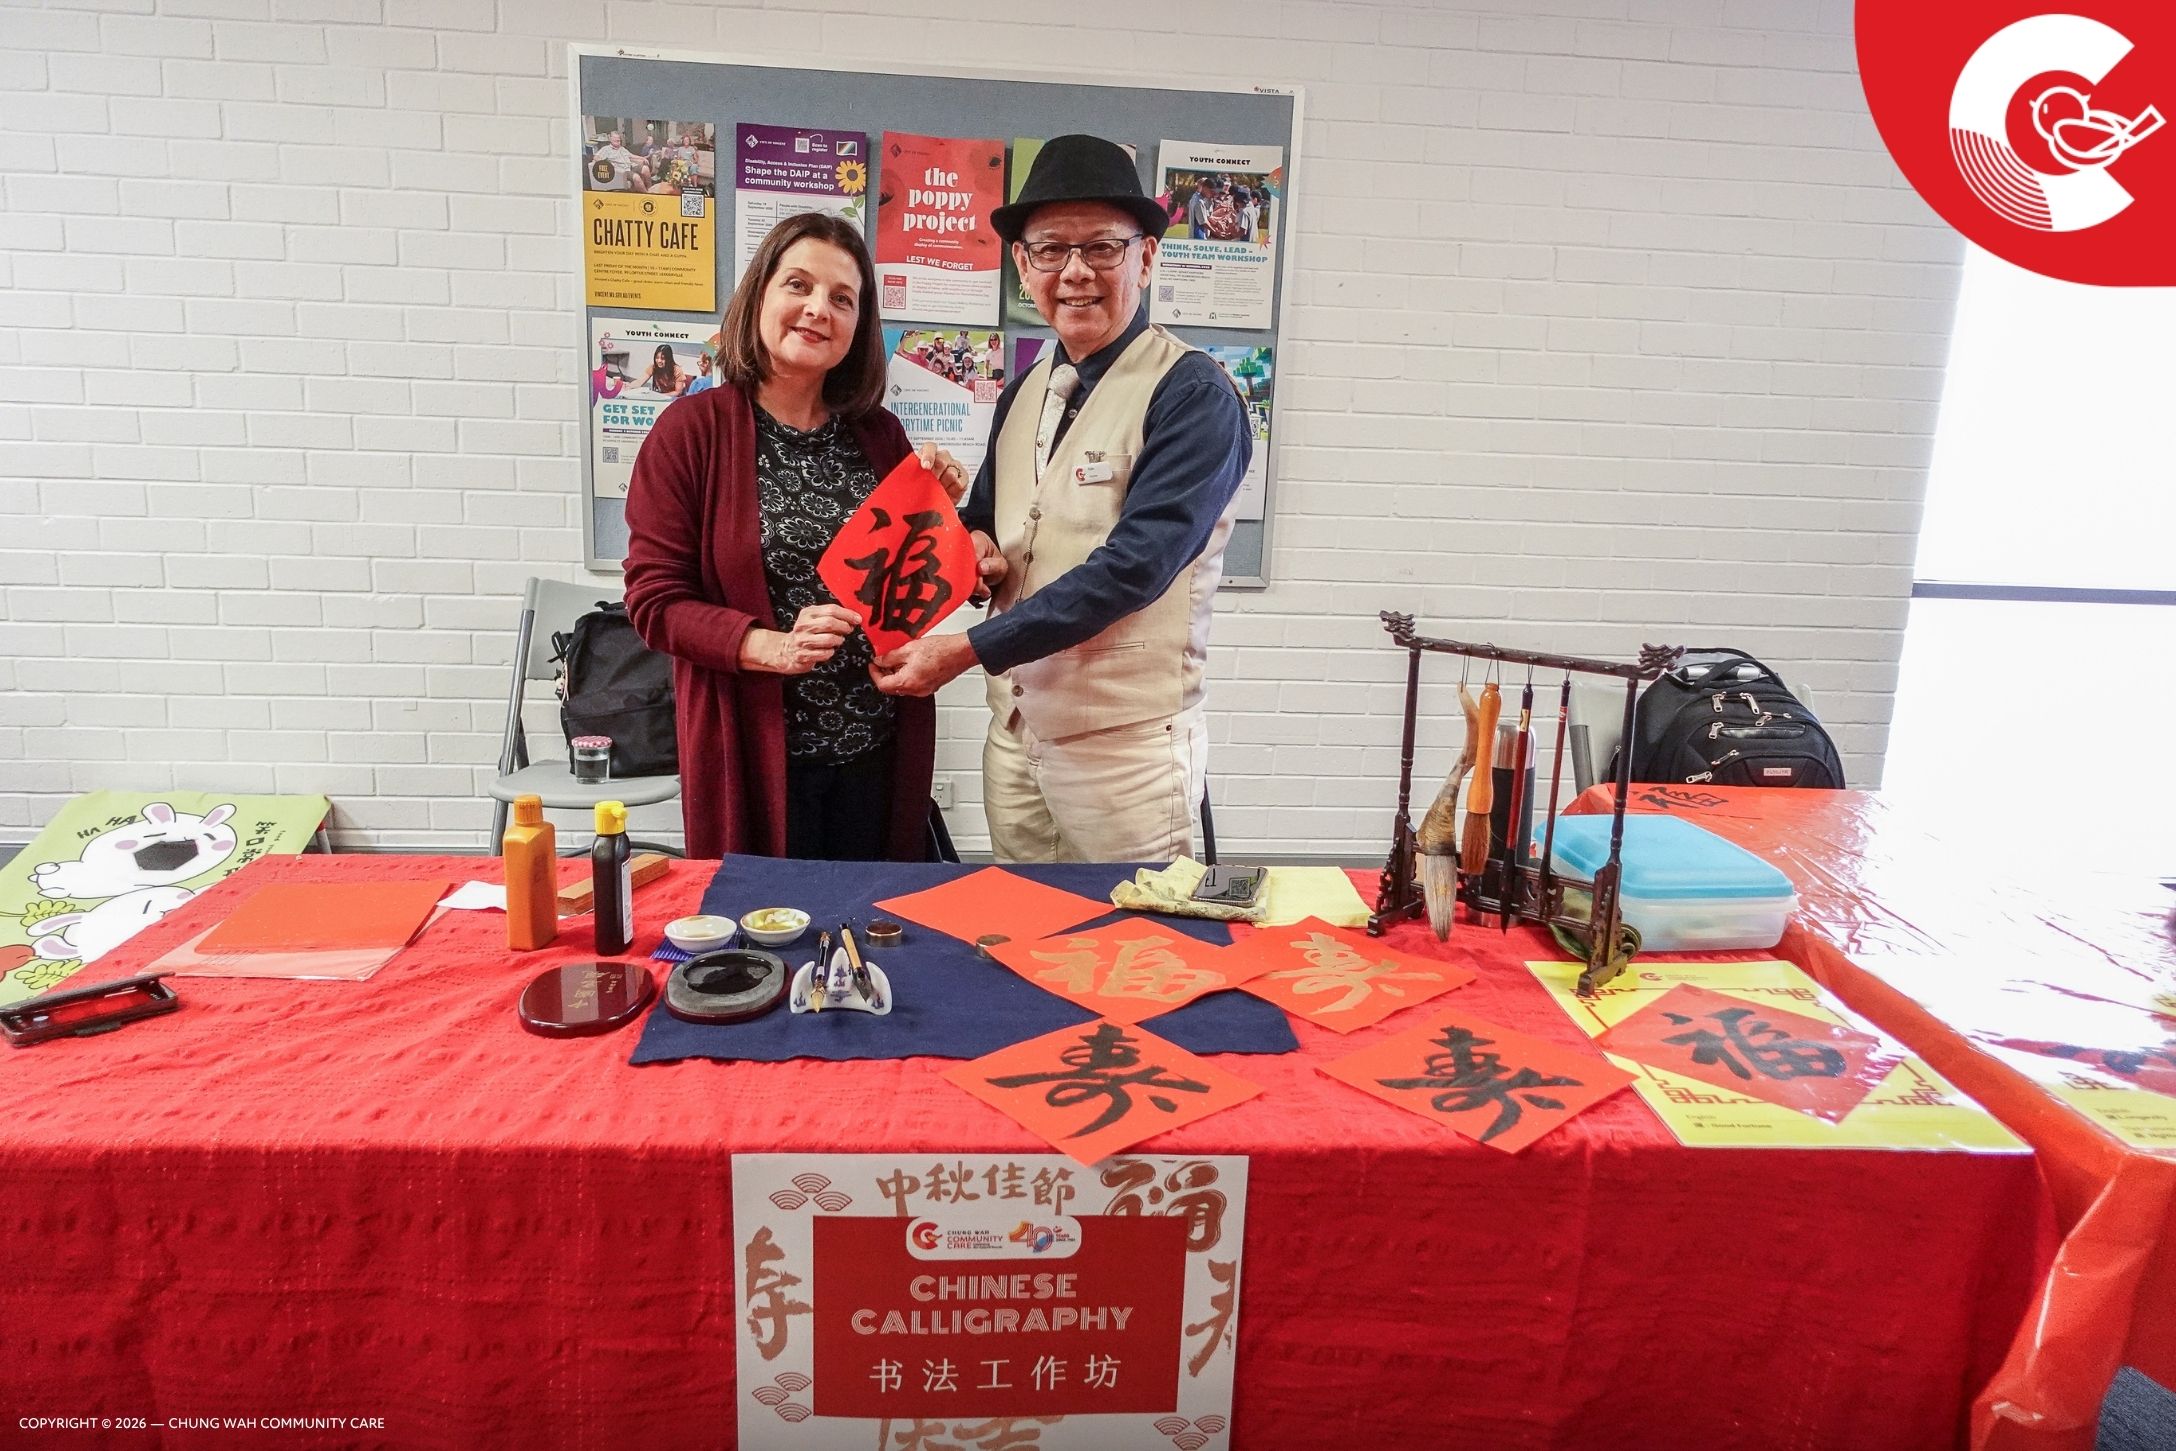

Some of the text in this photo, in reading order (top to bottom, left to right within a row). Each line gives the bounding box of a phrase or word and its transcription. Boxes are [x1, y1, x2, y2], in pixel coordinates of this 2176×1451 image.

[1189, 156, 1251, 166] YOUTH CONNECT
[745, 166, 772, 176] Shape
[774, 168, 788, 177] the
[790, 170, 810, 178] DAIP
[924, 168, 959, 188] the
[745, 178, 835, 192] community workshop
[908, 188, 972, 212] poppy
[902, 212, 976, 234] project
[594, 218, 698, 250] CHATTY CAFE
[1192, 252, 1215, 260] TEAM
[1217, 254, 1268, 263] WORKSHOP
[1193, 245, 1222, 253] SOLVE,
[1224, 246, 1247, 254] LEAD
[927, 258, 940, 266] WE
[942, 261, 974, 270] FORGET
[603, 404, 655, 415] GET SET
[890, 402, 970, 416] INTERGENERATIONAL
[603, 415, 654, 426] FOR WO
[901, 418, 963, 432] ORYTIME PICNIC
[843, 507, 953, 639] 福
[1030, 934, 1227, 1000] 福
[1659, 1007, 1848, 1082] 福
[876, 1160, 1076, 1217] 中秋佳節
[909, 1273, 1077, 1302] CHINESE
[851, 1306, 1134, 1335] CALLIGRAPHY
[869, 1354, 1122, 1393] 书法工作坊
